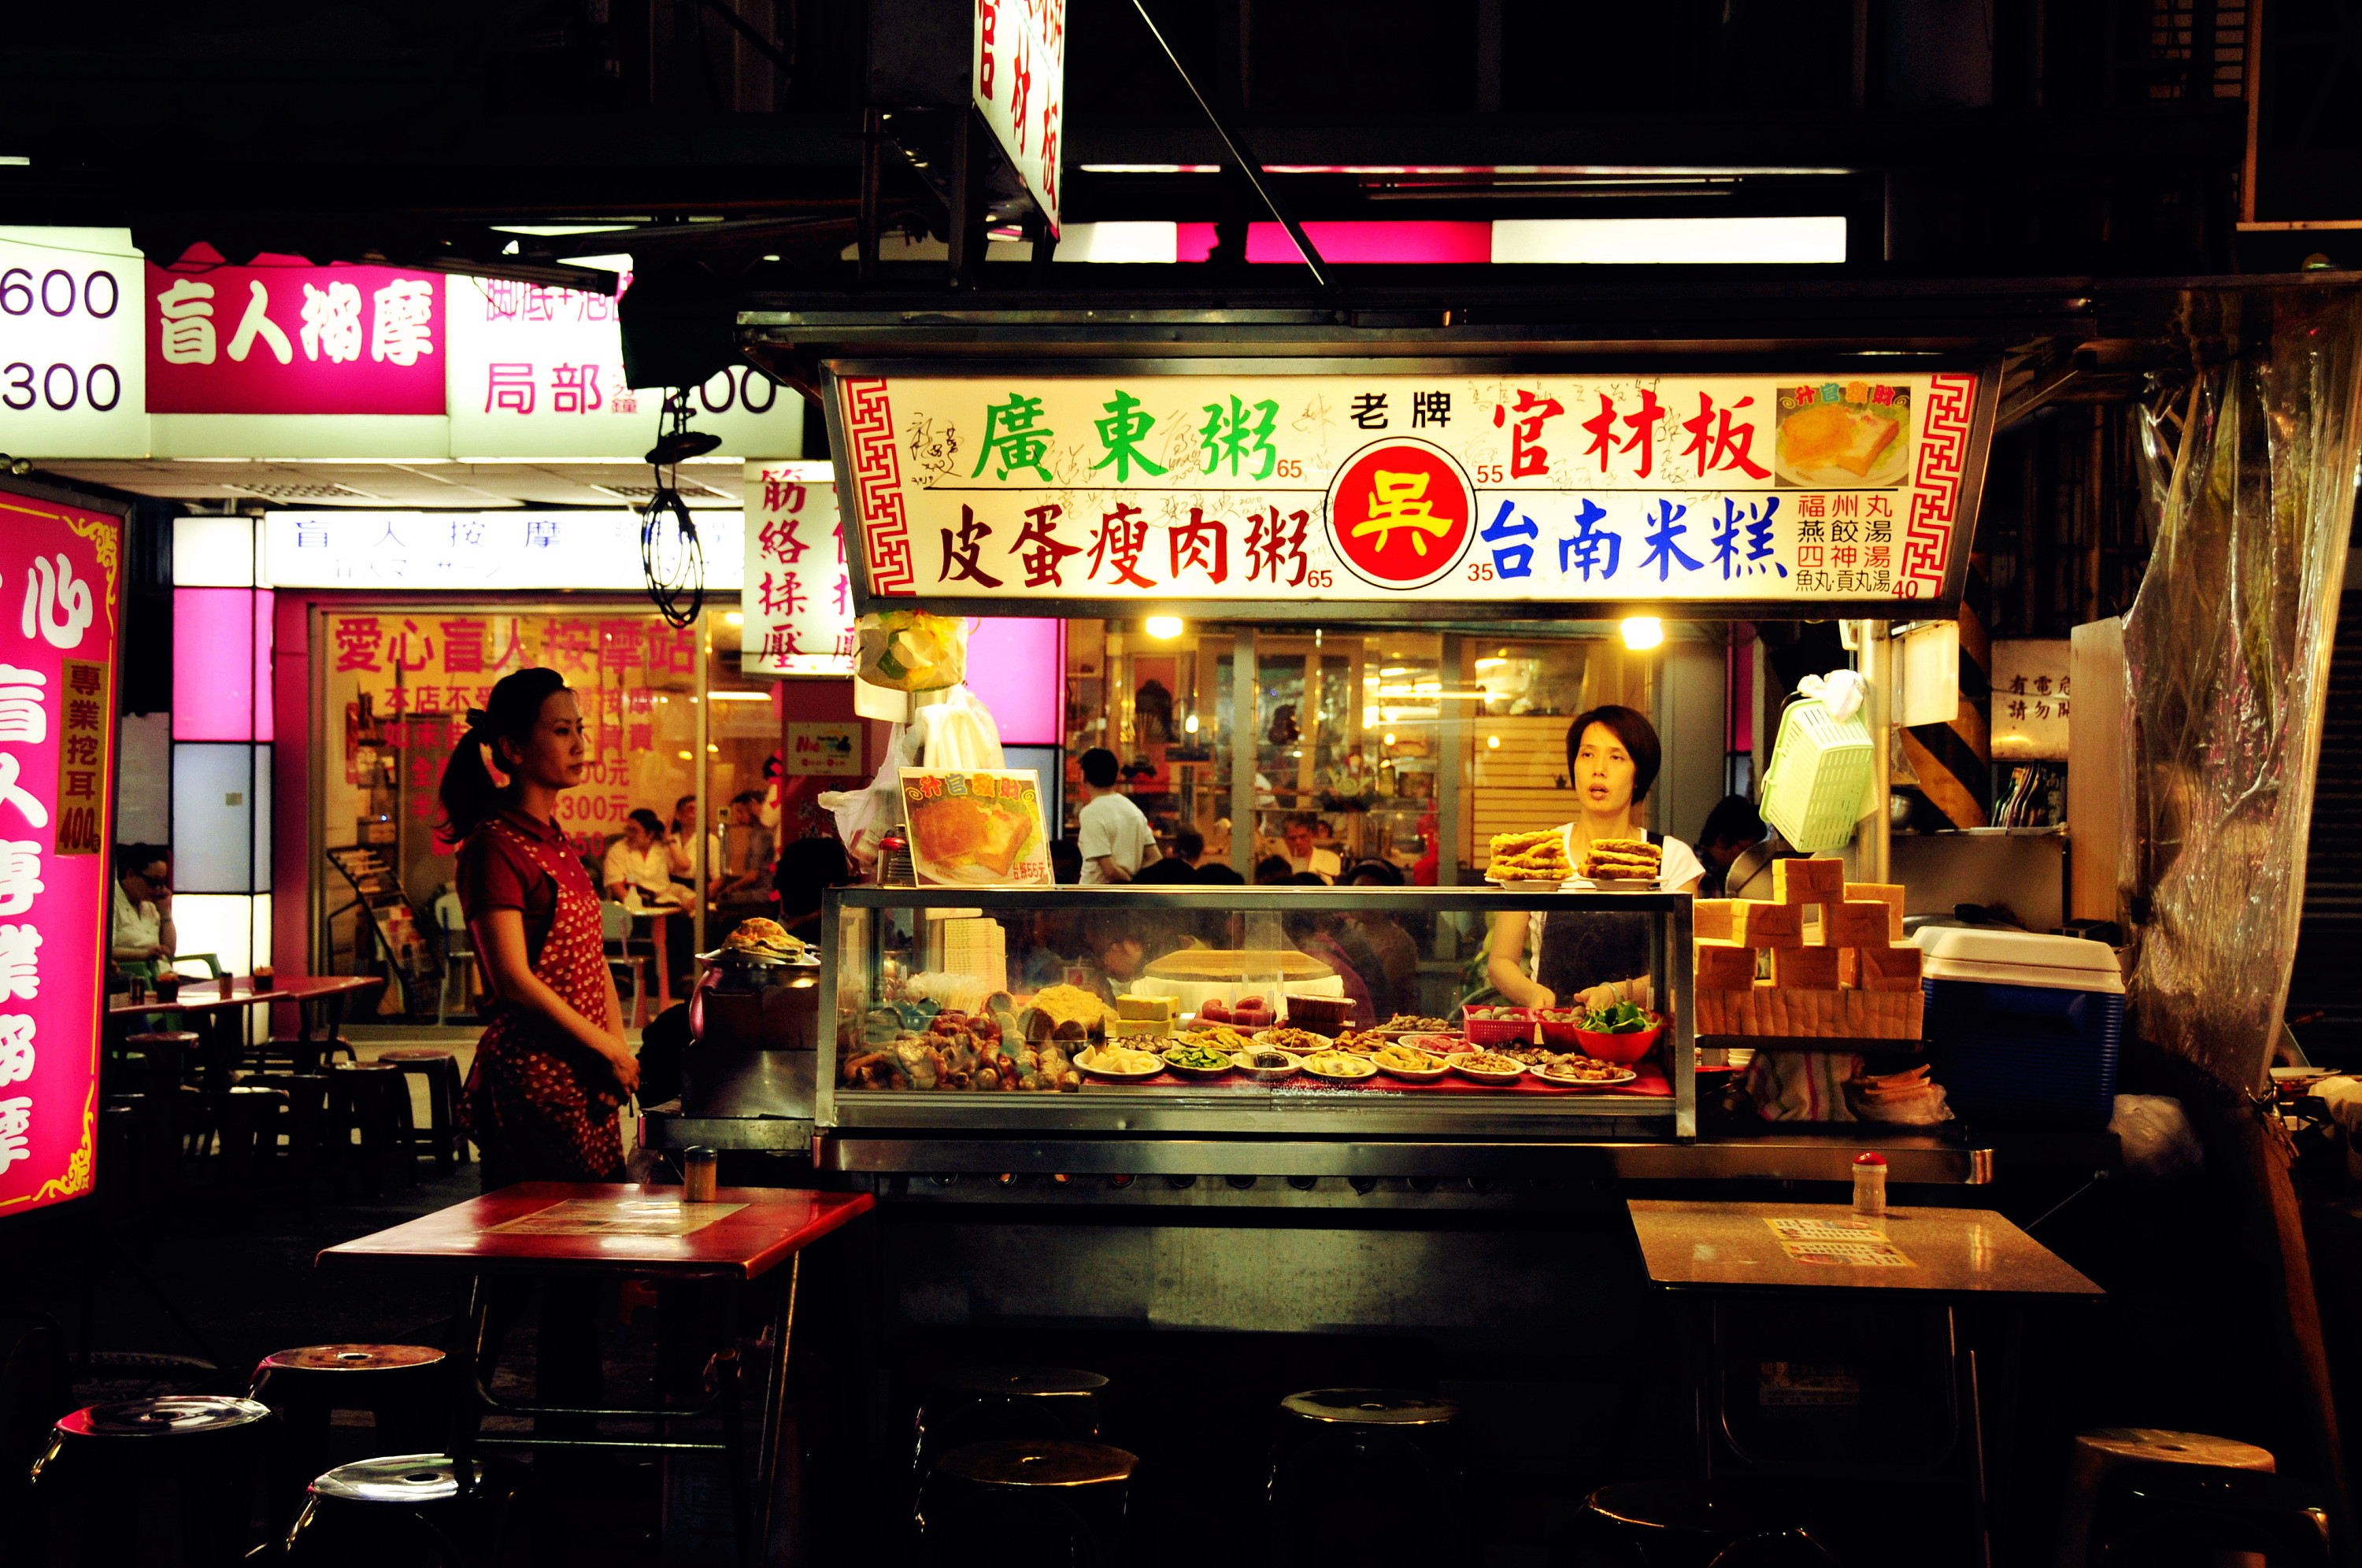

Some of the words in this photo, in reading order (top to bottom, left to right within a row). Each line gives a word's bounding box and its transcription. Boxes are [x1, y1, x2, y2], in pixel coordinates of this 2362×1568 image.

[0, 268, 119, 318] 600
[157, 278, 434, 366] 盲人按摩
[2, 362, 120, 412] 300
[485, 362, 602, 414] 局部
[1350, 390, 1451, 429] 老牌
[971, 389, 1280, 483] 廣東粥
[1276, 460, 1302, 478] 65
[1493, 388, 1772, 482] 官材板
[1476, 465, 1503, 483] 55
[1798, 494, 1893, 518] 福州丸
[294, 520, 562, 549] 盲人按摩
[937, 503, 1308, 589] 皮蛋瘦肉粥
[1307, 570, 1333, 588] 65
[1480, 496, 1788, 582] 台南米糕
[1797, 520, 1893, 543] 燕餃湯
[1797, 545, 1891, 568] 四神湯
[758, 468, 810, 668] 筋絡揉壓
[1467, 563, 1494, 582] 35
[1891, 579, 1920, 599] 40
[335, 618, 697, 675] 愛心盲人按摩站
[65, 665, 101, 801] 專業挖耳
